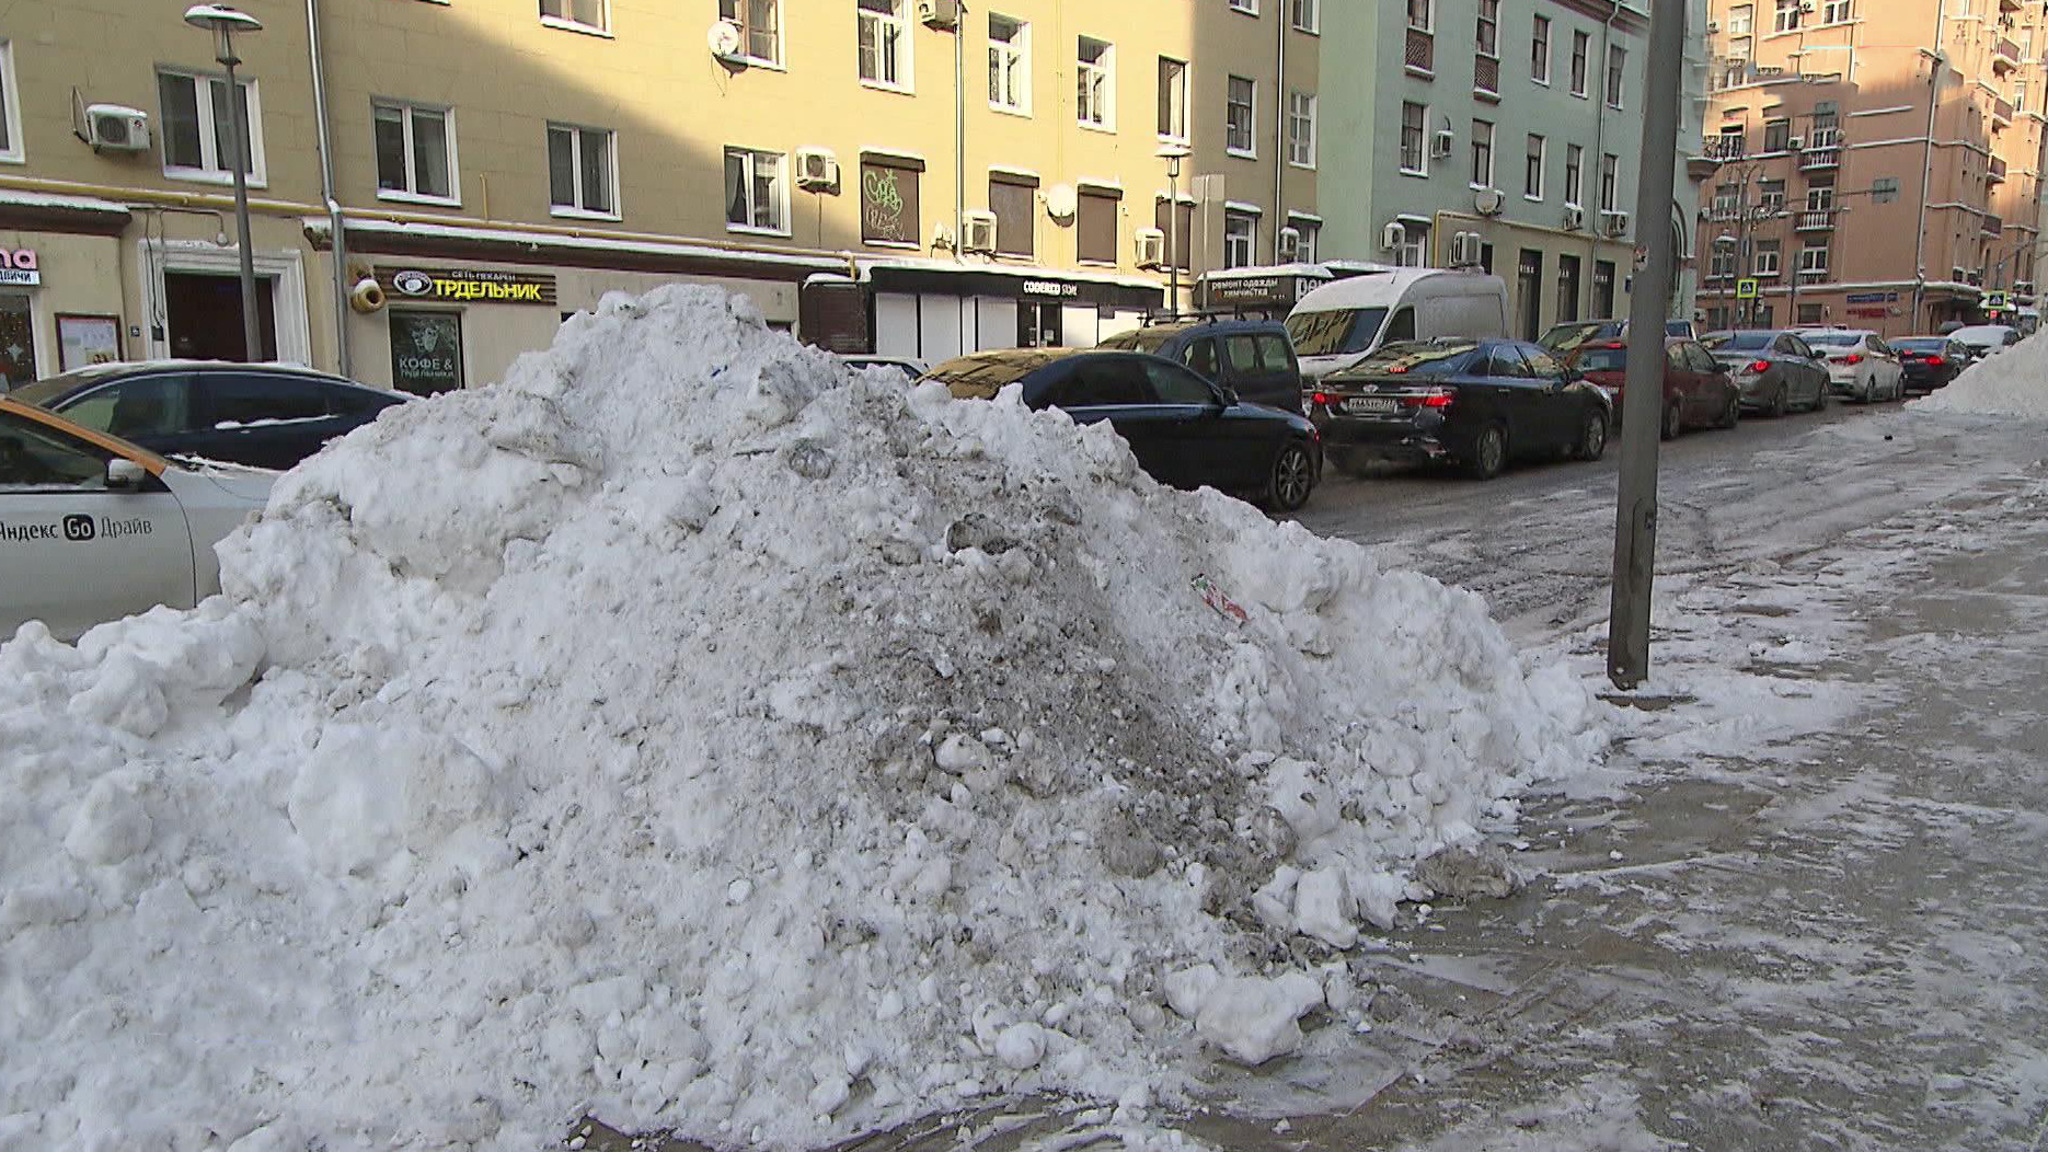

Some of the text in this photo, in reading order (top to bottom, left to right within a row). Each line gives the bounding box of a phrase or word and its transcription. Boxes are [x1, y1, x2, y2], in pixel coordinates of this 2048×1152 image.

[433, 279, 541, 300] ТРДЕЛЬНИК
[400, 357, 440, 370] КОФЕ
[0, 520, 58, 542] Яндекс
[67, 518, 92, 537] Go
[101, 516, 152, 538] Драйв
